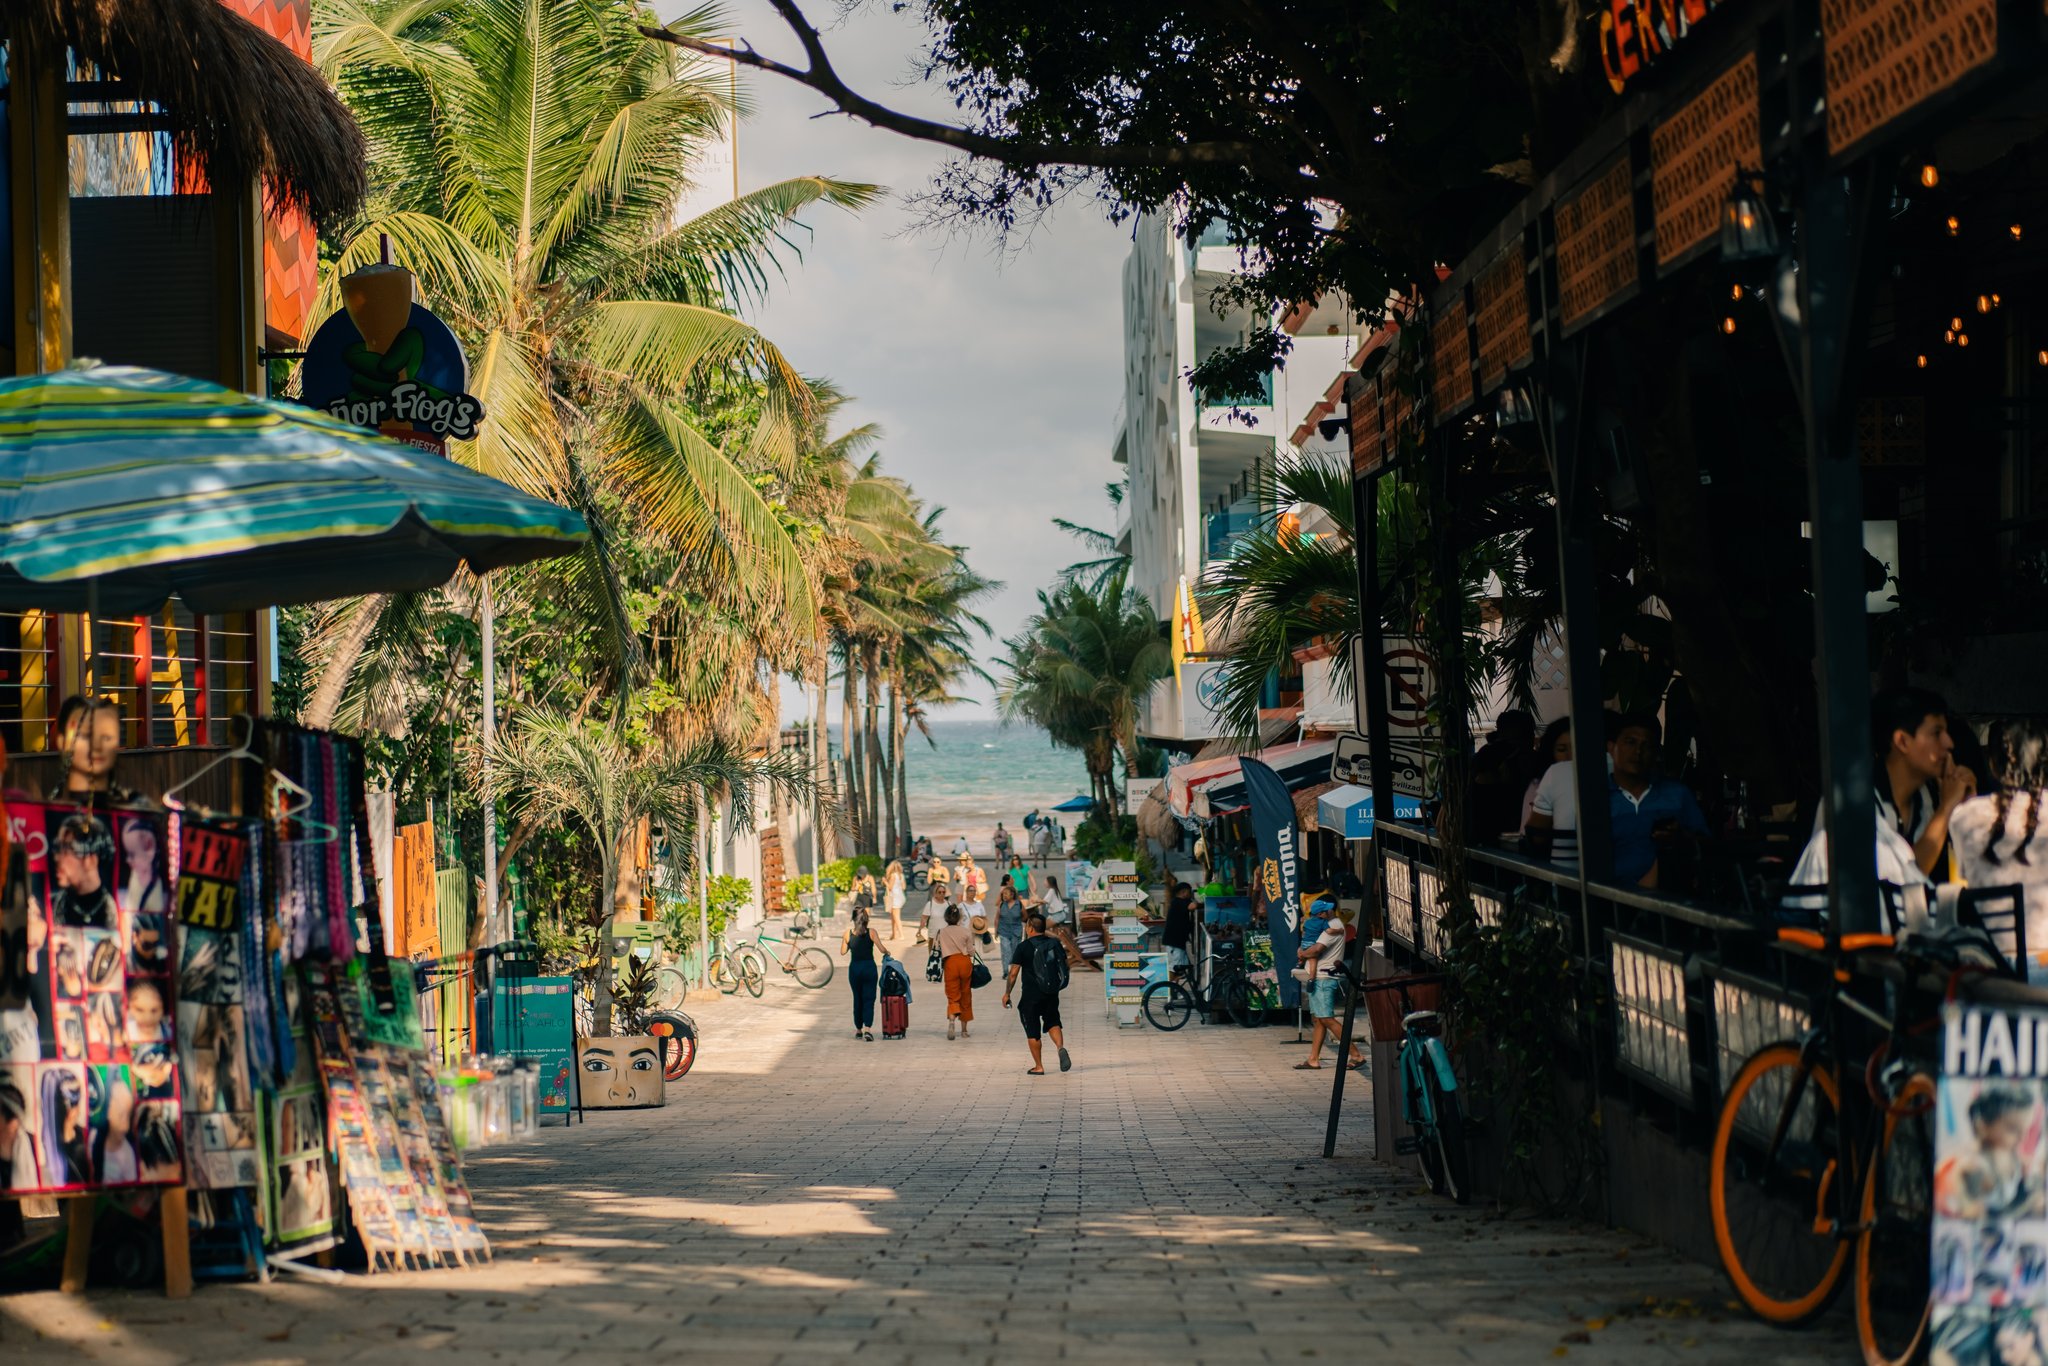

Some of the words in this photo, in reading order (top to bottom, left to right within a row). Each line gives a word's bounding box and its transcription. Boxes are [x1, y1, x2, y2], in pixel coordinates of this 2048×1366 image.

[317, 399, 387, 426] ñor
[391, 383, 475, 436] Frog's
[409, 438, 442, 456] FIESTA
[1388, 666, 1425, 712] E
[1277, 826, 1299, 934] Corona
